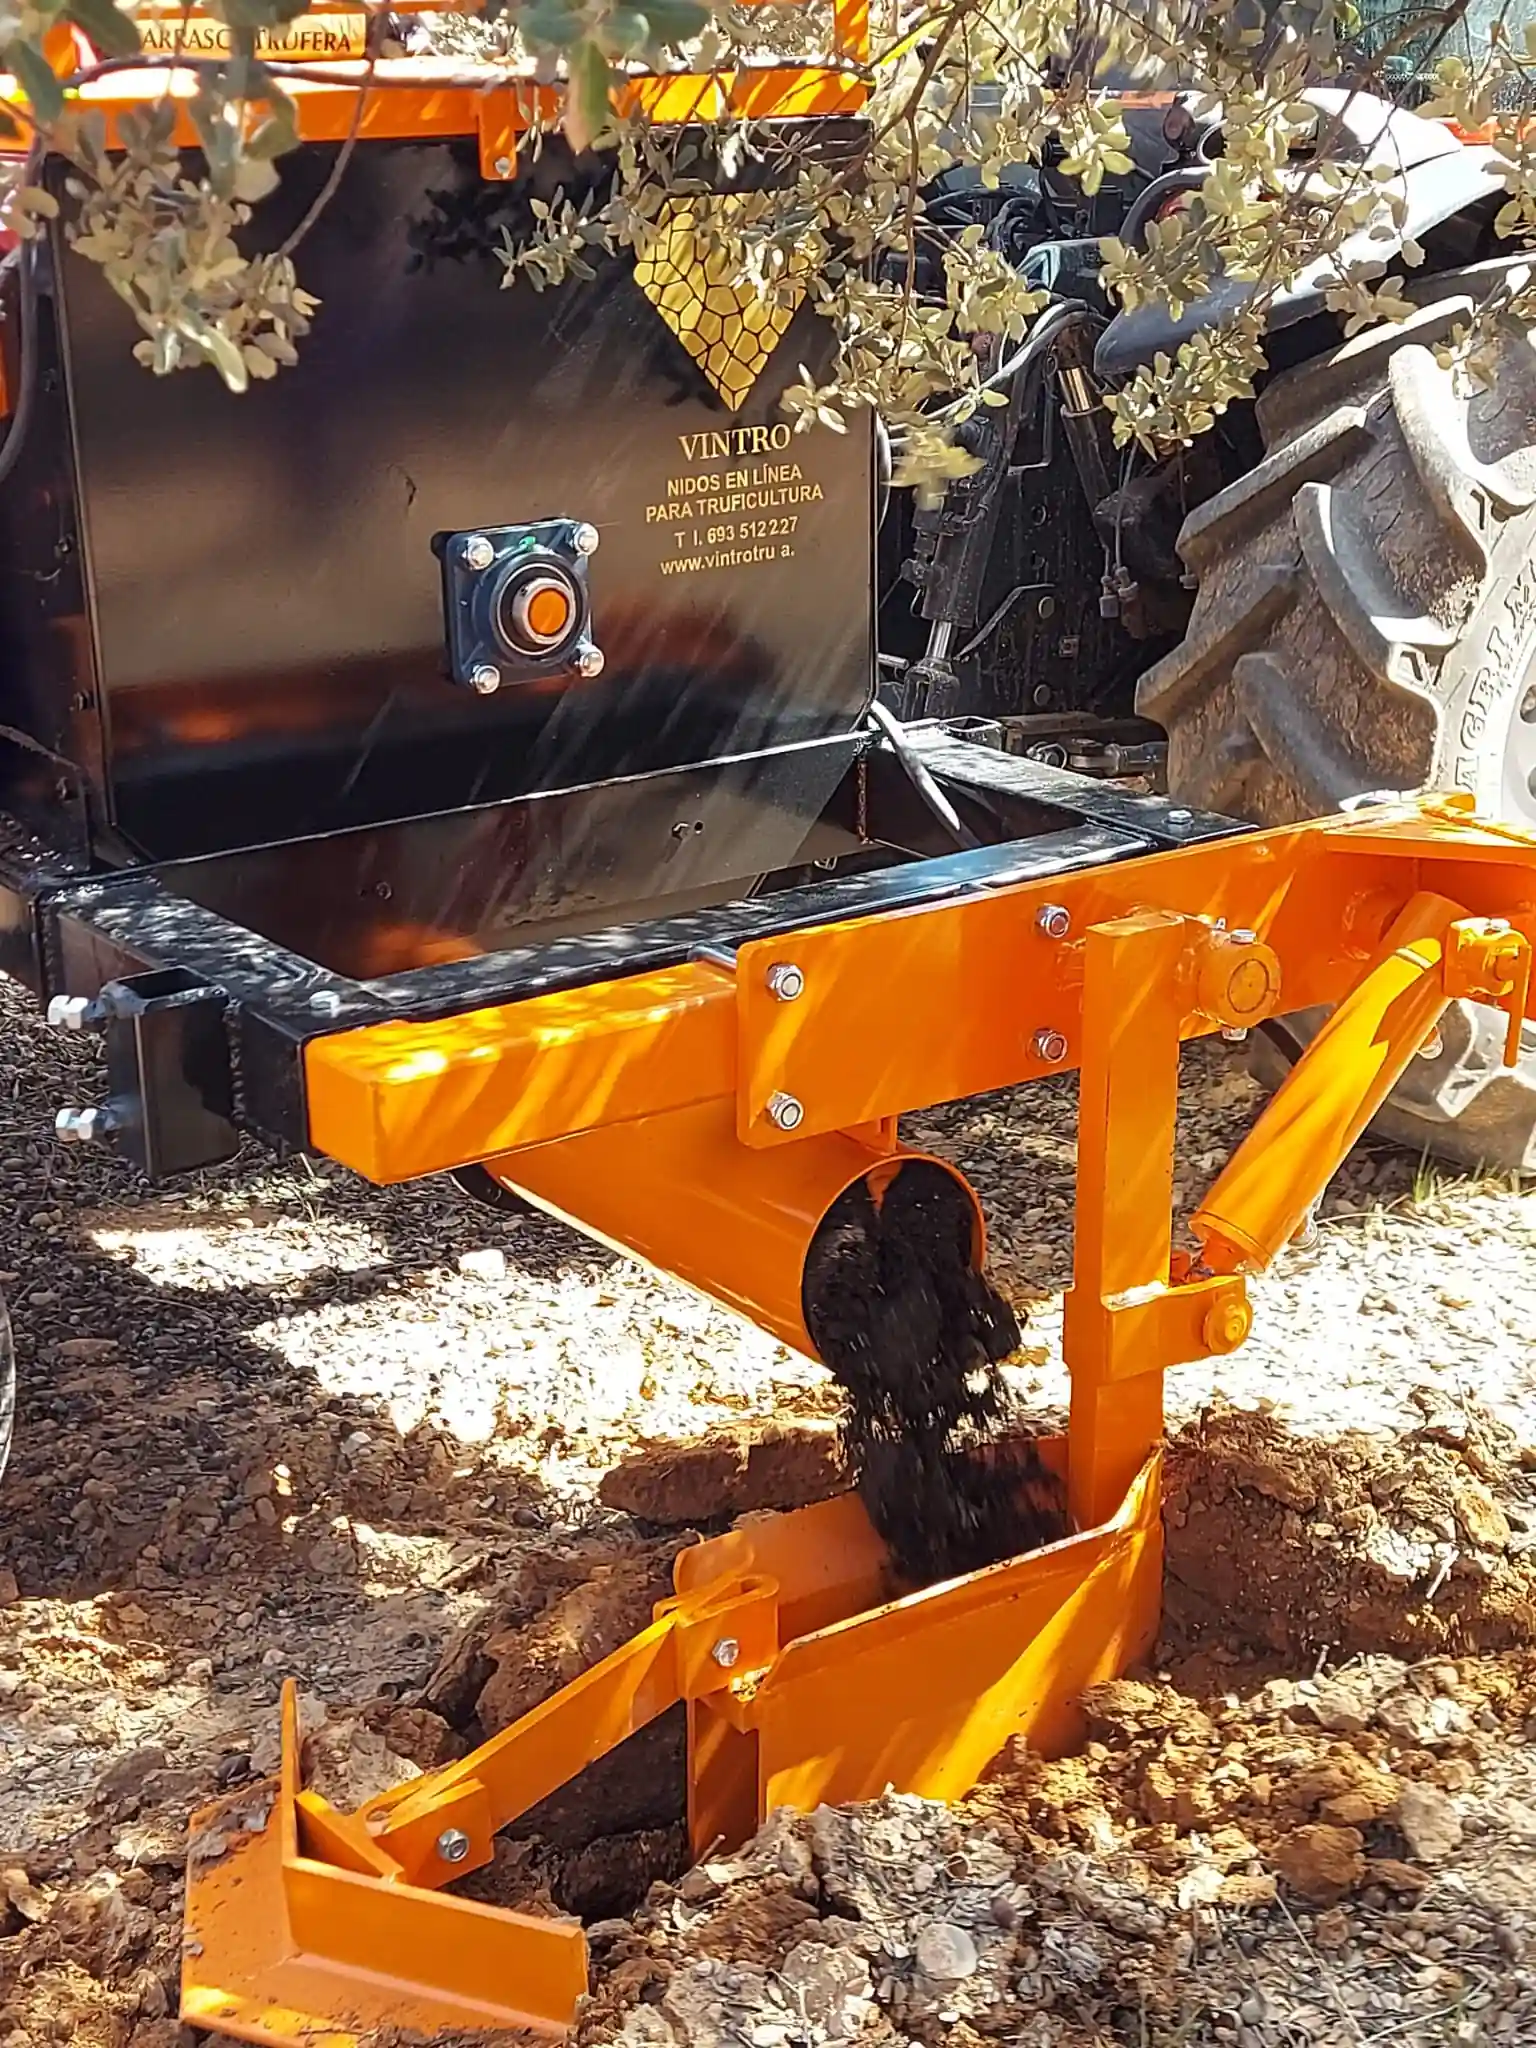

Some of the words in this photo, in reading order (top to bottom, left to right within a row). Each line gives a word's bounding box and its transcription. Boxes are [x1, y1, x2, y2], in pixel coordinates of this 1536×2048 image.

[142, 28, 232, 51] ARRASC
[678, 424, 791, 461] VINTRO
[667, 474, 720, 497] NIDOS
[726, 469, 748, 489] EN
[753, 463, 802, 485] LÍNEA
[646, 502, 693, 523] PARA
[696, 484, 824, 516] TRUFICULTURA
[707, 525, 735, 544] 693
